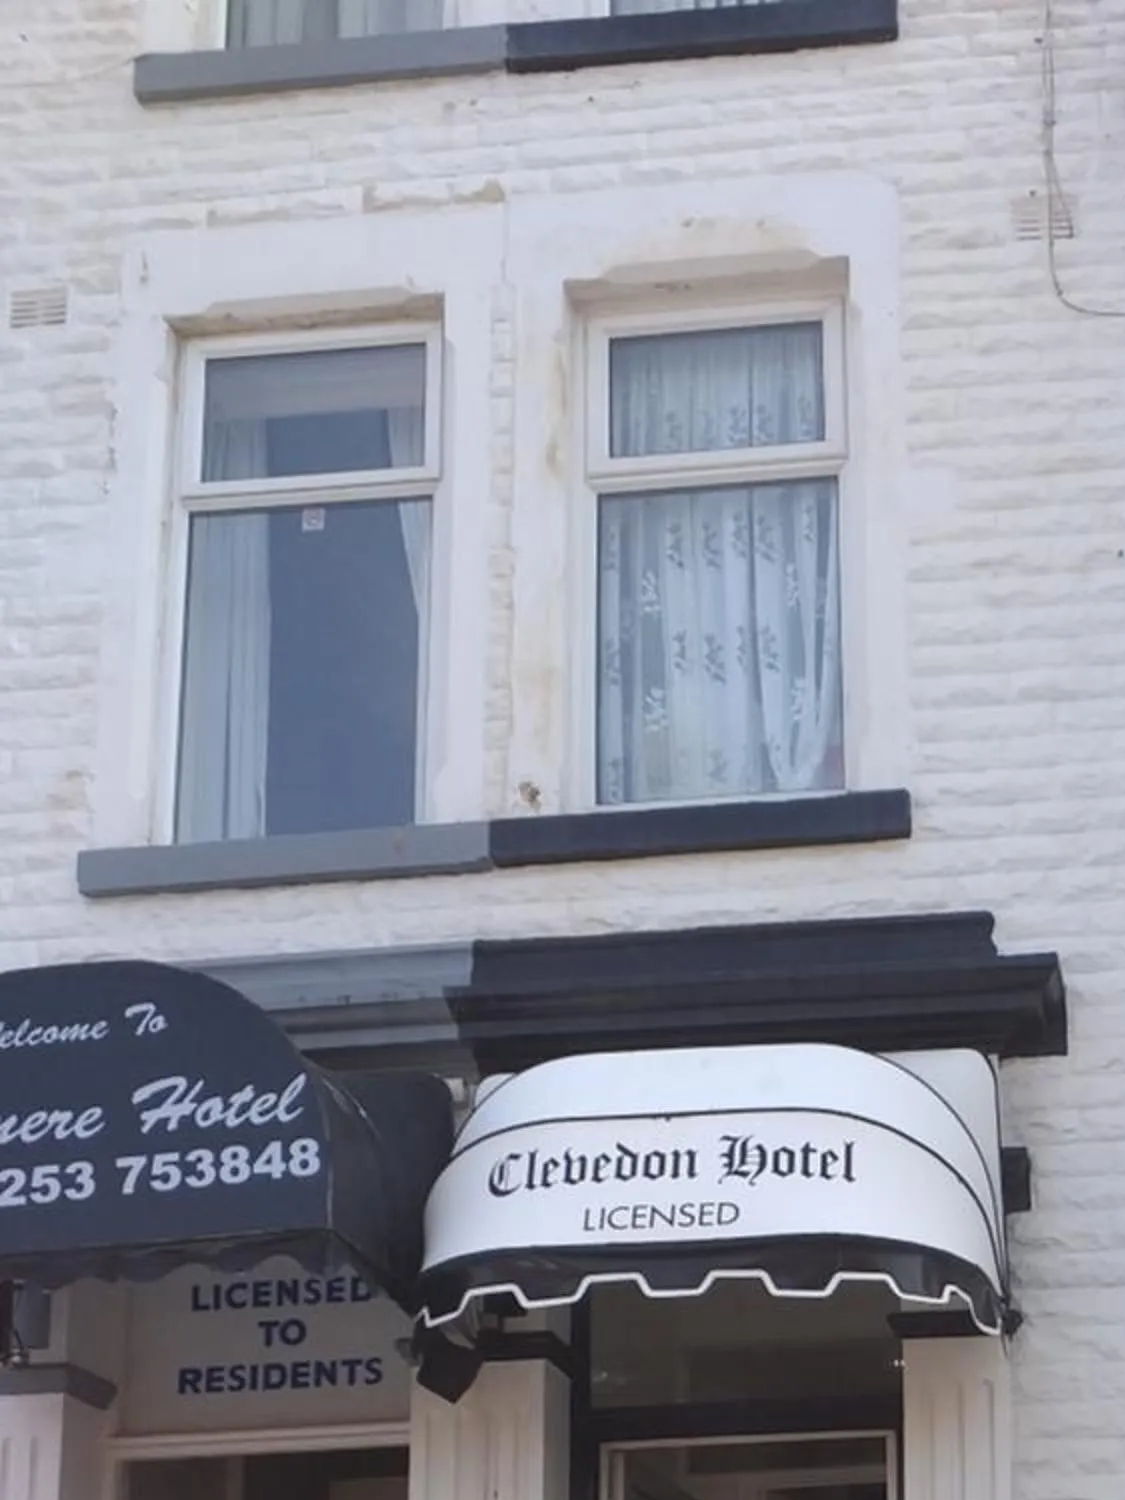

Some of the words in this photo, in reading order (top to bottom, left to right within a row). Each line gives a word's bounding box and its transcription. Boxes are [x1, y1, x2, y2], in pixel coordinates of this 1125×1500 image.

[0, 1018, 109, 1049] elcome
[124, 1002, 168, 1036] To
[131, 1072, 307, 1134] Hotel
[116, 1138, 320, 1195] 753848
[488, 1143, 698, 1198] Clevedon
[719, 1134, 857, 1187] Hotel
[583, 1202, 740, 1232] LICENSED
[190, 1275, 373, 1312] LICENSED
[258, 1319, 307, 1347] TO
[177, 1358, 384, 1395] RESIDENTS
